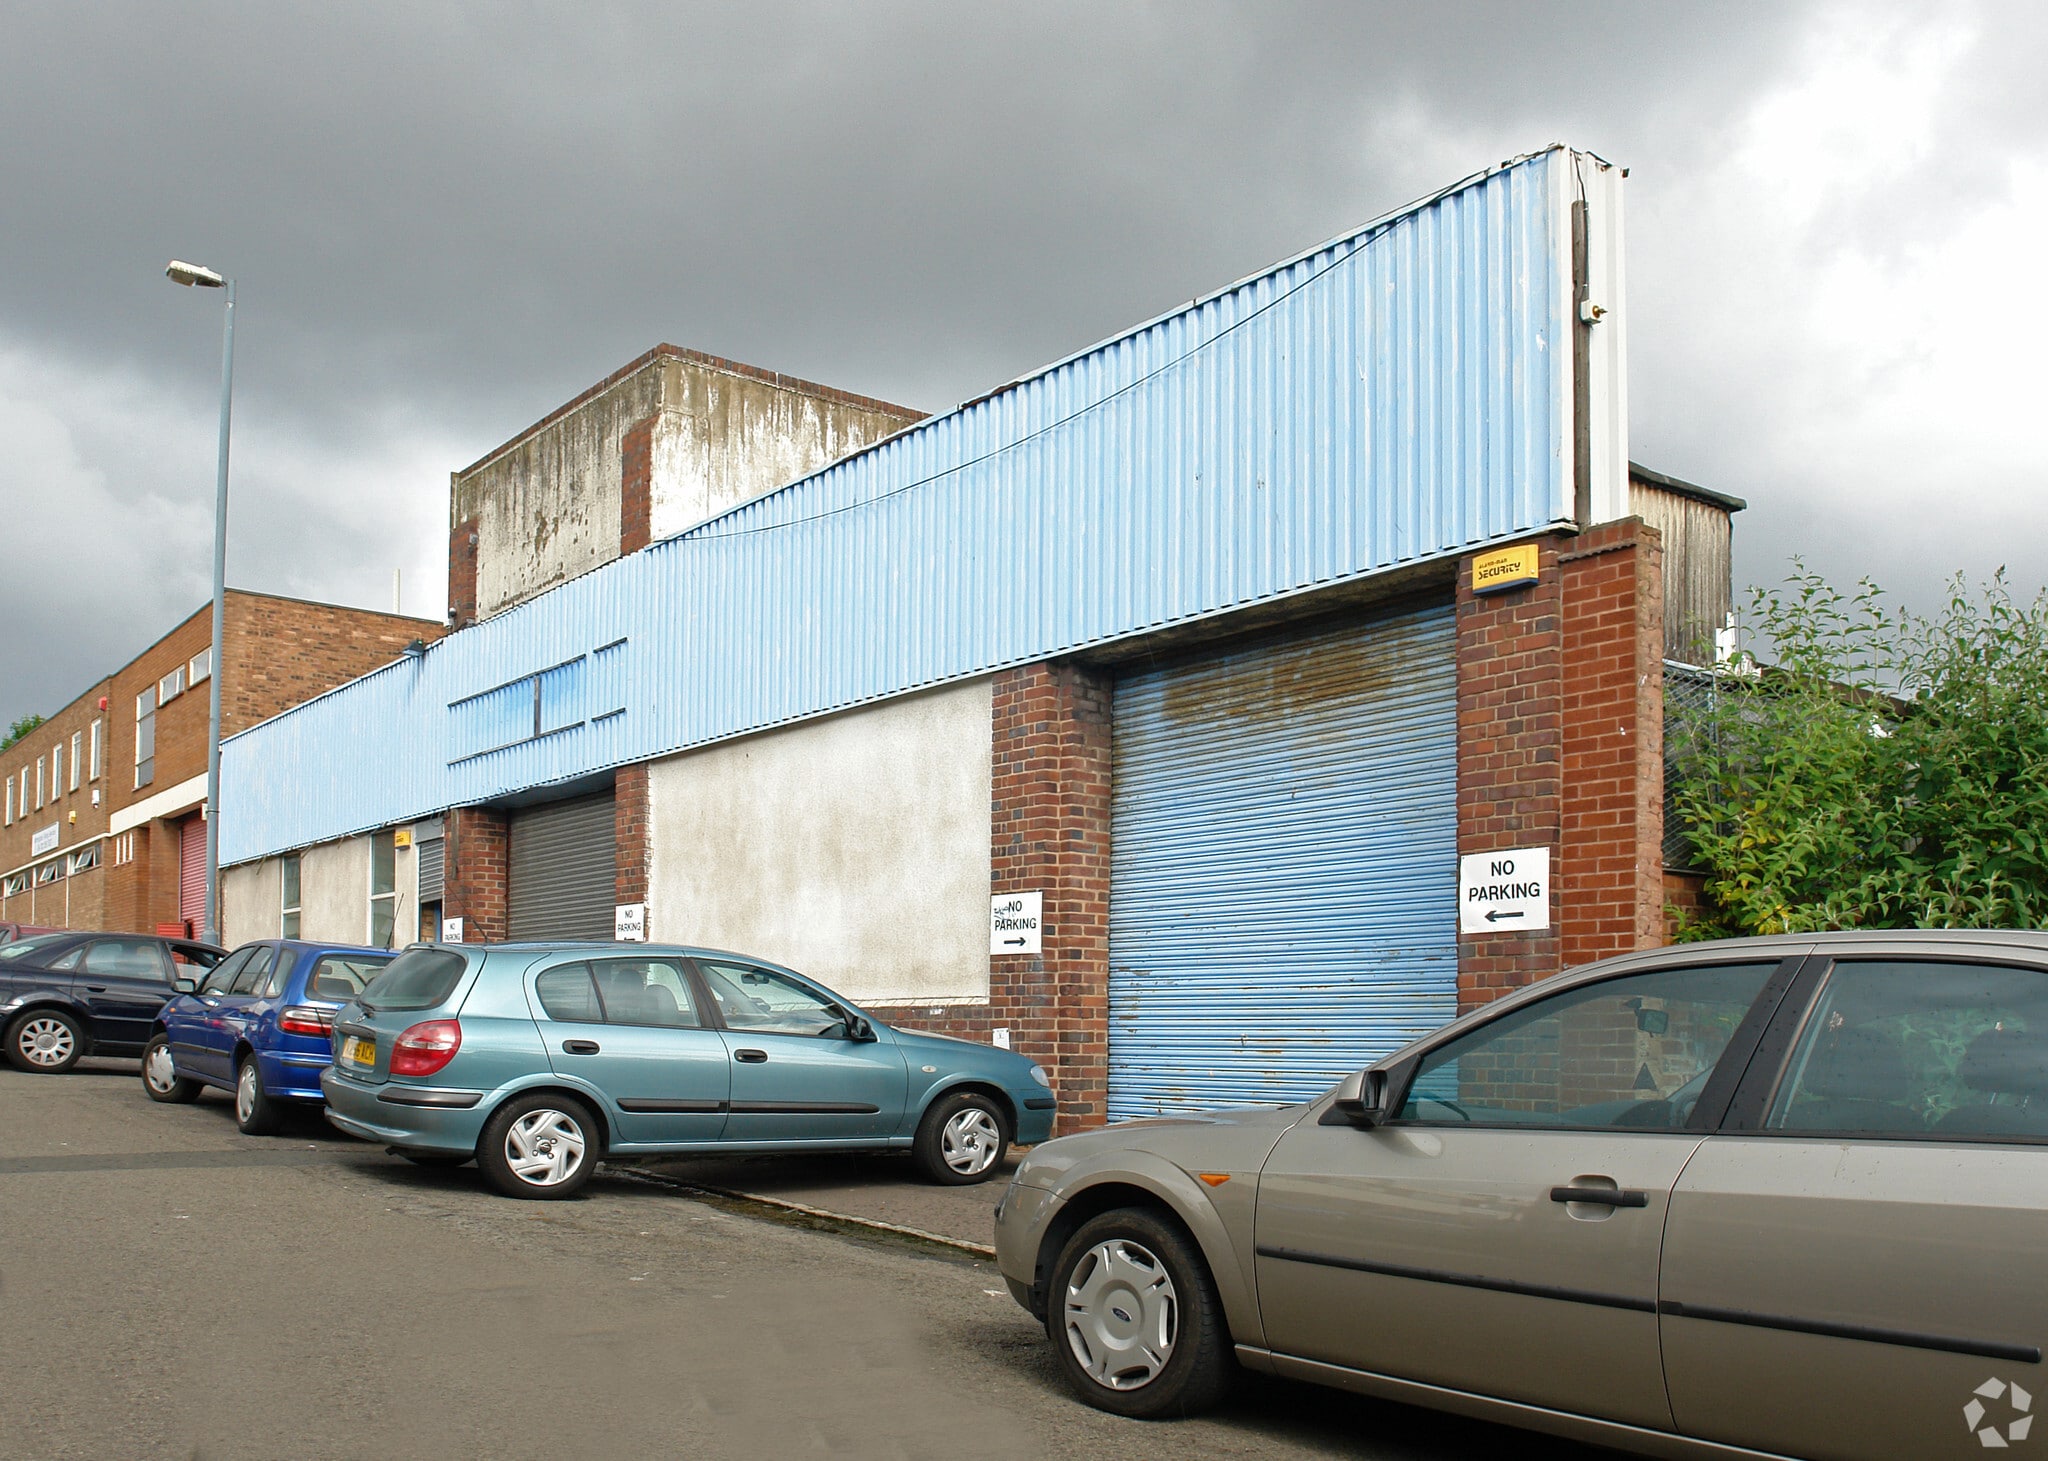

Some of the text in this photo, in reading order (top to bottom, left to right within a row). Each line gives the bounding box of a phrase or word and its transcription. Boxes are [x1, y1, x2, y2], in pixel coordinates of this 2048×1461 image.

[1491, 860, 1515, 877] NO
[1468, 882, 1540, 902] PARKING
[1008, 900, 1023, 912] NO
[624, 909, 634, 919] NO
[617, 922, 641, 932] PARKING
[994, 917, 1037, 931] PARKING
